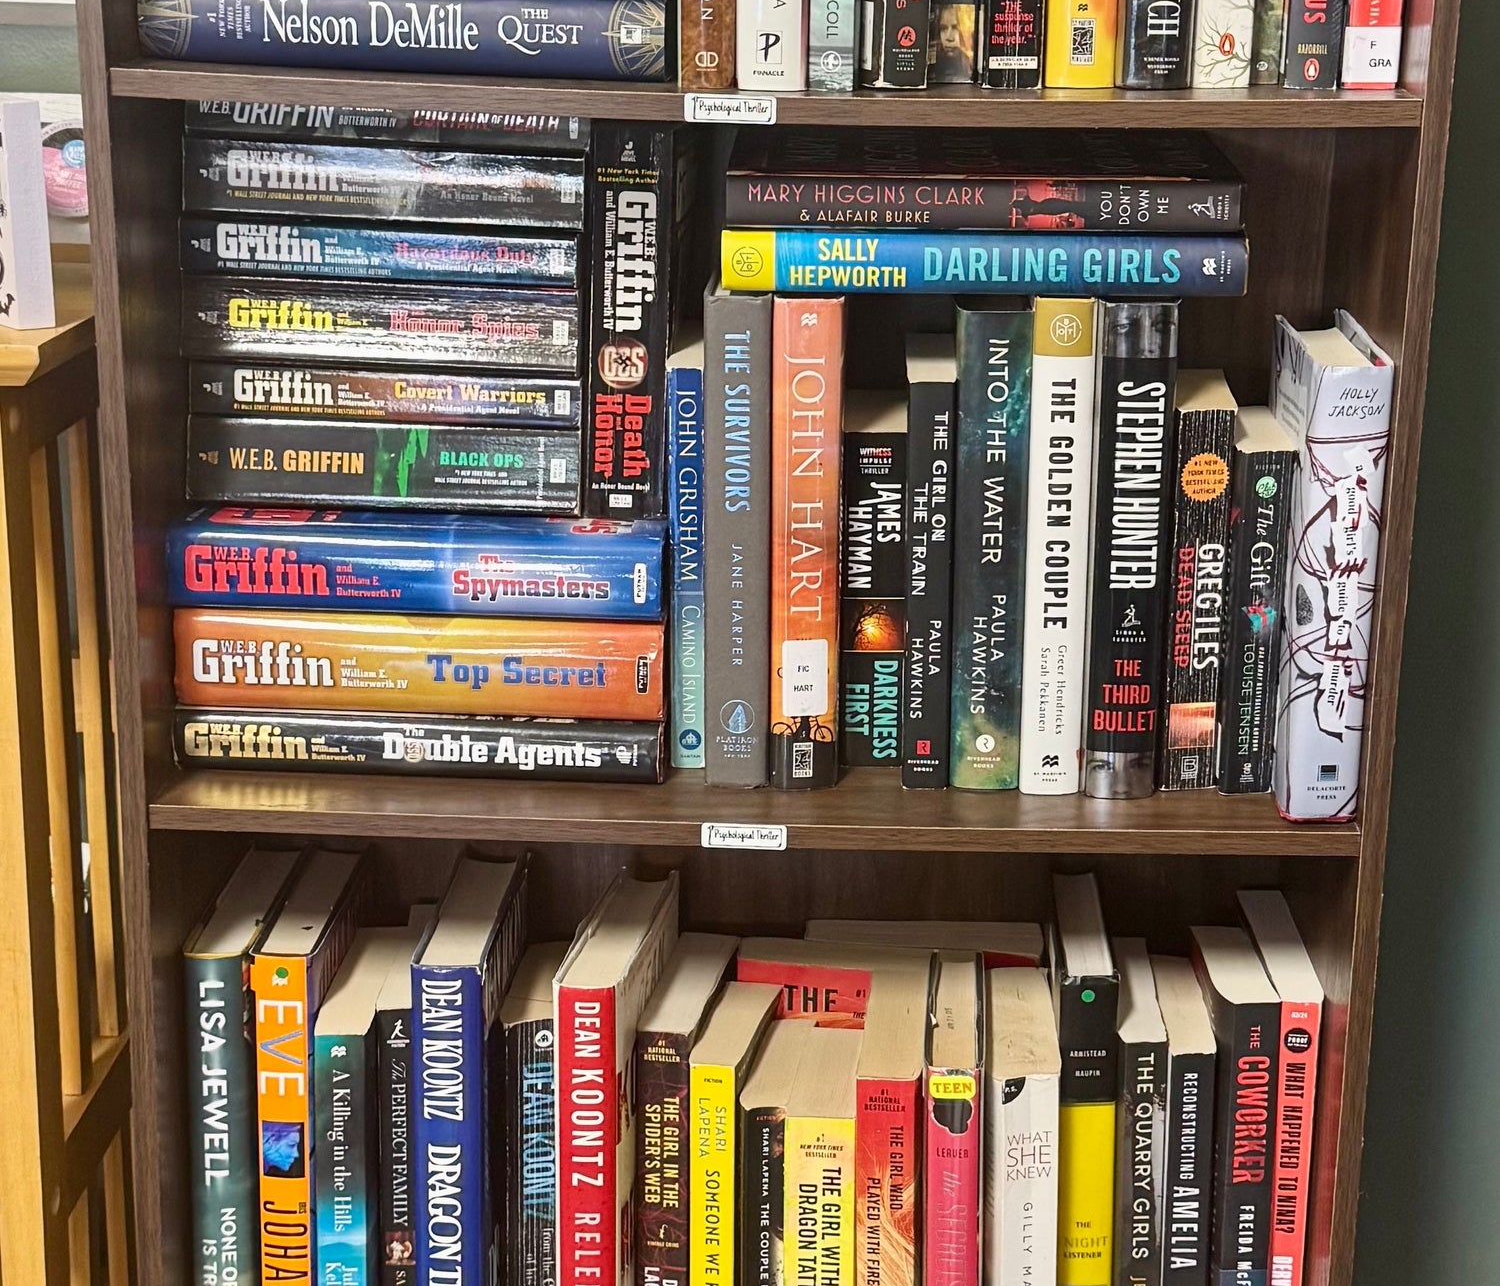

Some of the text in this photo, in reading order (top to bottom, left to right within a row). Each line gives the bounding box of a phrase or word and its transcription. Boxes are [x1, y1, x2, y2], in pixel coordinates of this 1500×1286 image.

[521, 9, 549, 19] THE
[368, 0, 479, 51] DeMille
[498, 14, 584, 52] QUEST
[1370, 40, 1377, 49] F
[1369, 58, 1392, 68] GRA
[818, 239, 879, 261] SALLY
[924, 247, 1181, 283] DARLING GIRLS
[789, 264, 907, 288] HEPWORTH
[1340, 387, 1378, 401] HOLLY
[1328, 402, 1385, 418] JACKSON
[731, 544, 743, 667] JANE HARPER
[427, 654, 606, 690] Top Secret
[1114, 660, 1141, 677] THE
[1102, 684, 1151, 704] THIRD
[1093, 710, 1154, 732] BULLET
[257, 999, 304, 1096] EVE
[1074, 1069, 1101, 1077] MAUPIN
[1007, 1131, 1052, 1147] WHAT
[1007, 1146, 1051, 1167] SHE
[1006, 1165, 1051, 1180] KNEW
[704, 1169, 721, 1245] SOMEONE
[705, 1252, 720, 1278] WE
